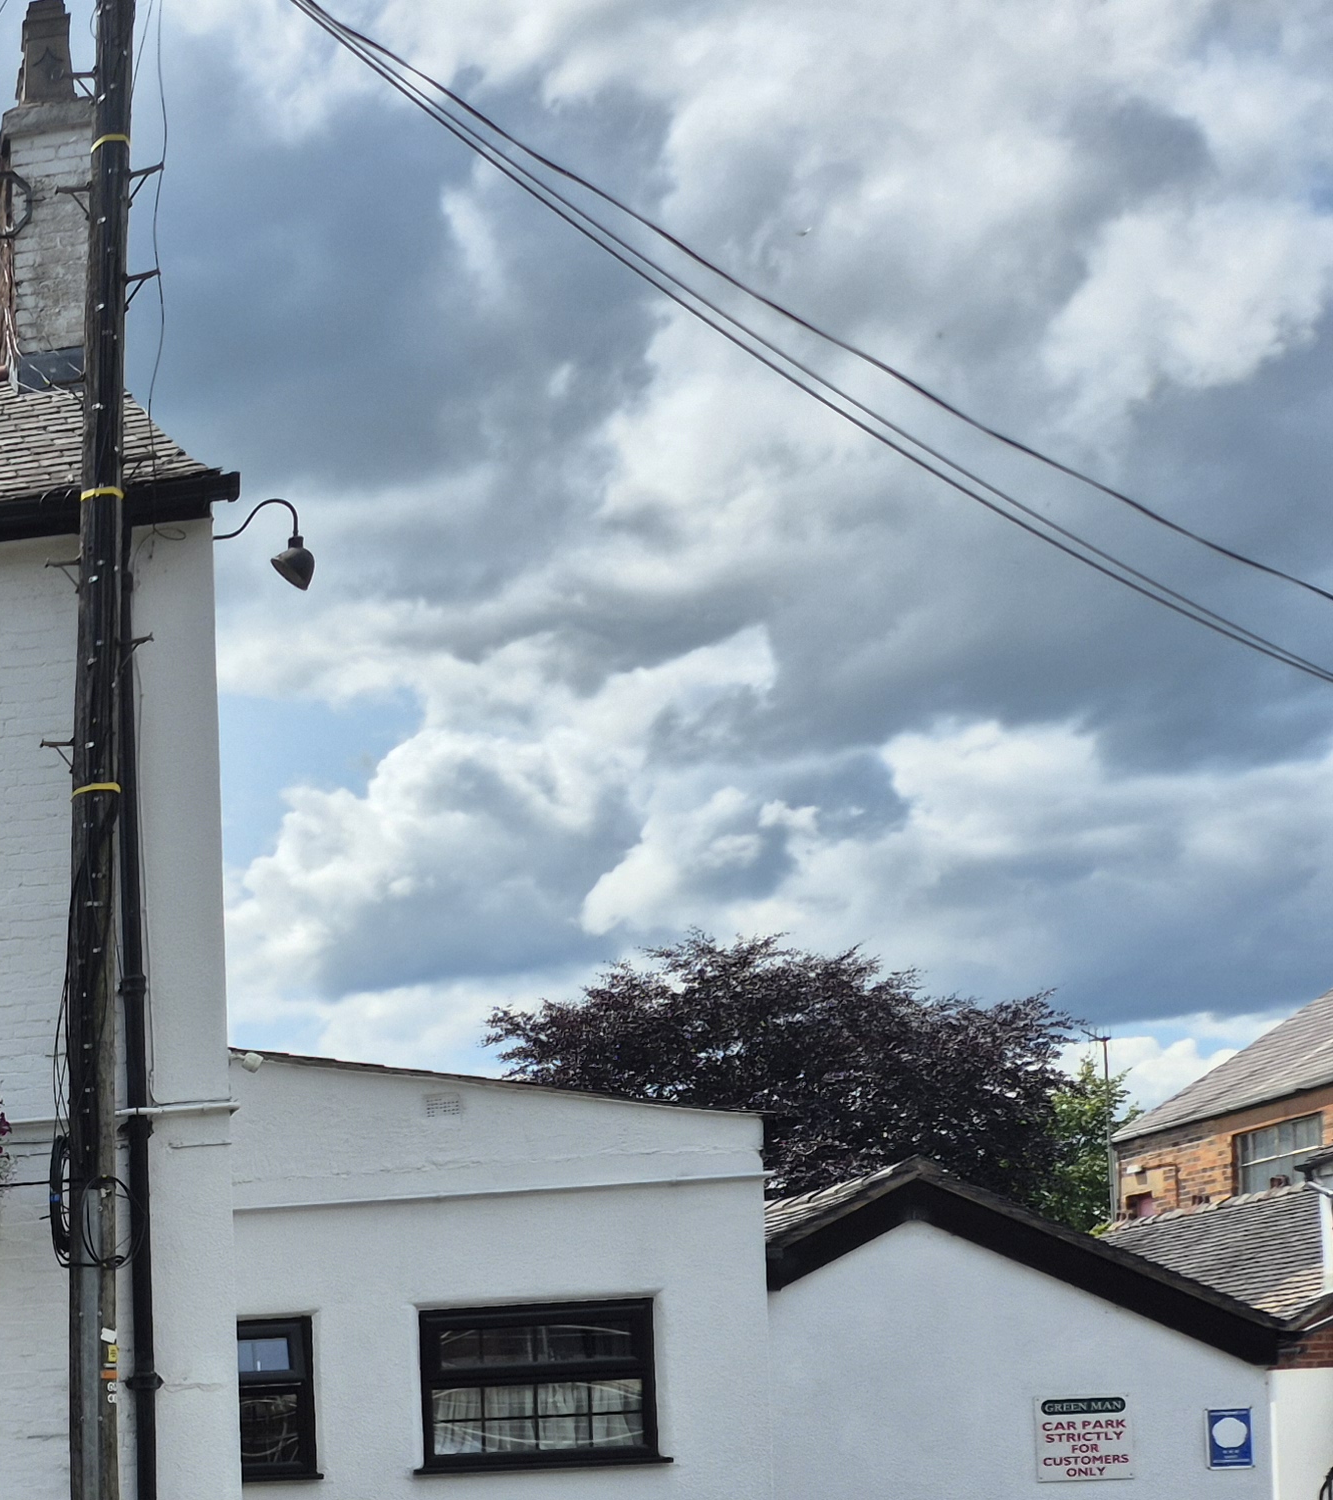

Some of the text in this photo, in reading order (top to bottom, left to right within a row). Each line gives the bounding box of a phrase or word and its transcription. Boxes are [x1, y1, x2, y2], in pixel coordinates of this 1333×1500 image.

[1044, 1400, 1122, 1413] GREEN MAN
[1041, 1418, 1127, 1432] CAR PARK
[1045, 1430, 1124, 1443] STRICTLY
[1071, 1443, 1099, 1454] FOR
[1042, 1454, 1129, 1467] CUSTOMERS
[1066, 1466, 1106, 1477] ONLY
